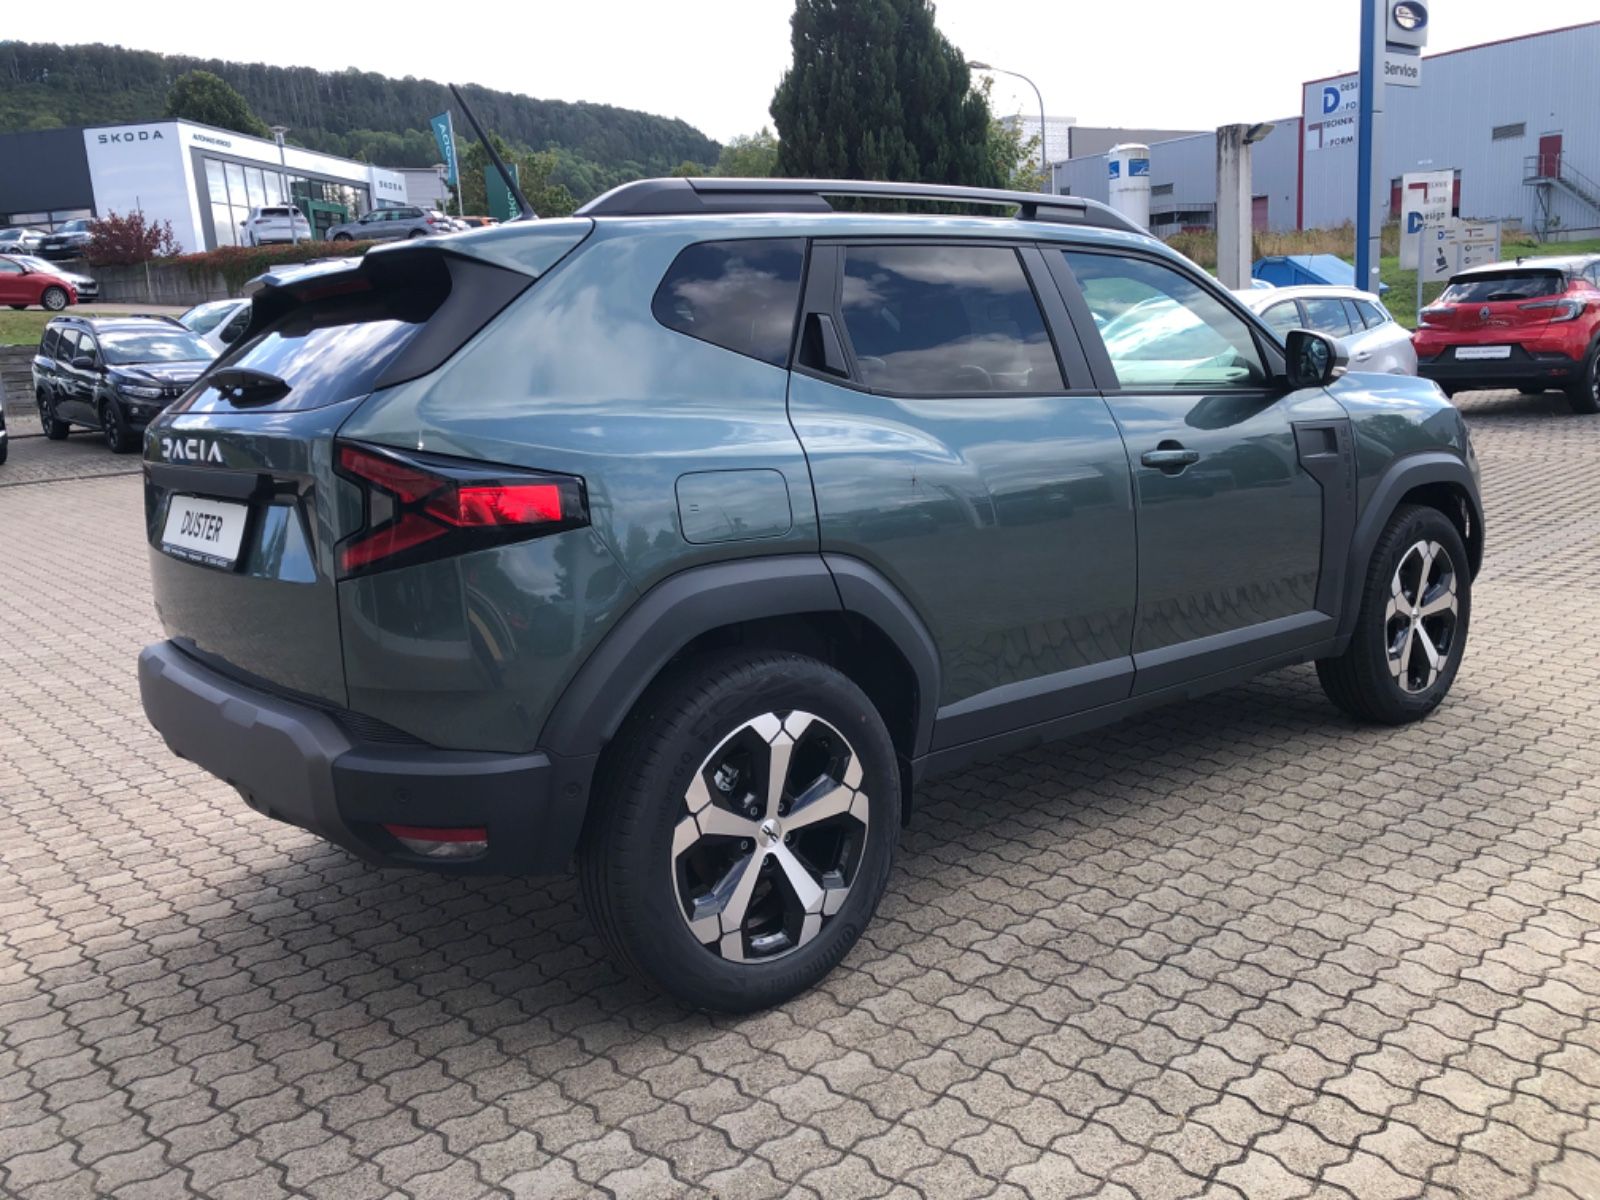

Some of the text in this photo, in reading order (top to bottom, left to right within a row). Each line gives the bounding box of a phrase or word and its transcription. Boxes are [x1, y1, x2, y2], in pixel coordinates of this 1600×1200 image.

[1384, 60, 1418, 78] Service
[1323, 117, 1354, 128] TECHNIK
[98, 130, 164, 144] SKODA
[1330, 136, 1353, 146] FORM
[162, 438, 223, 462] DACIA
[181, 510, 223, 542] DUSTER
